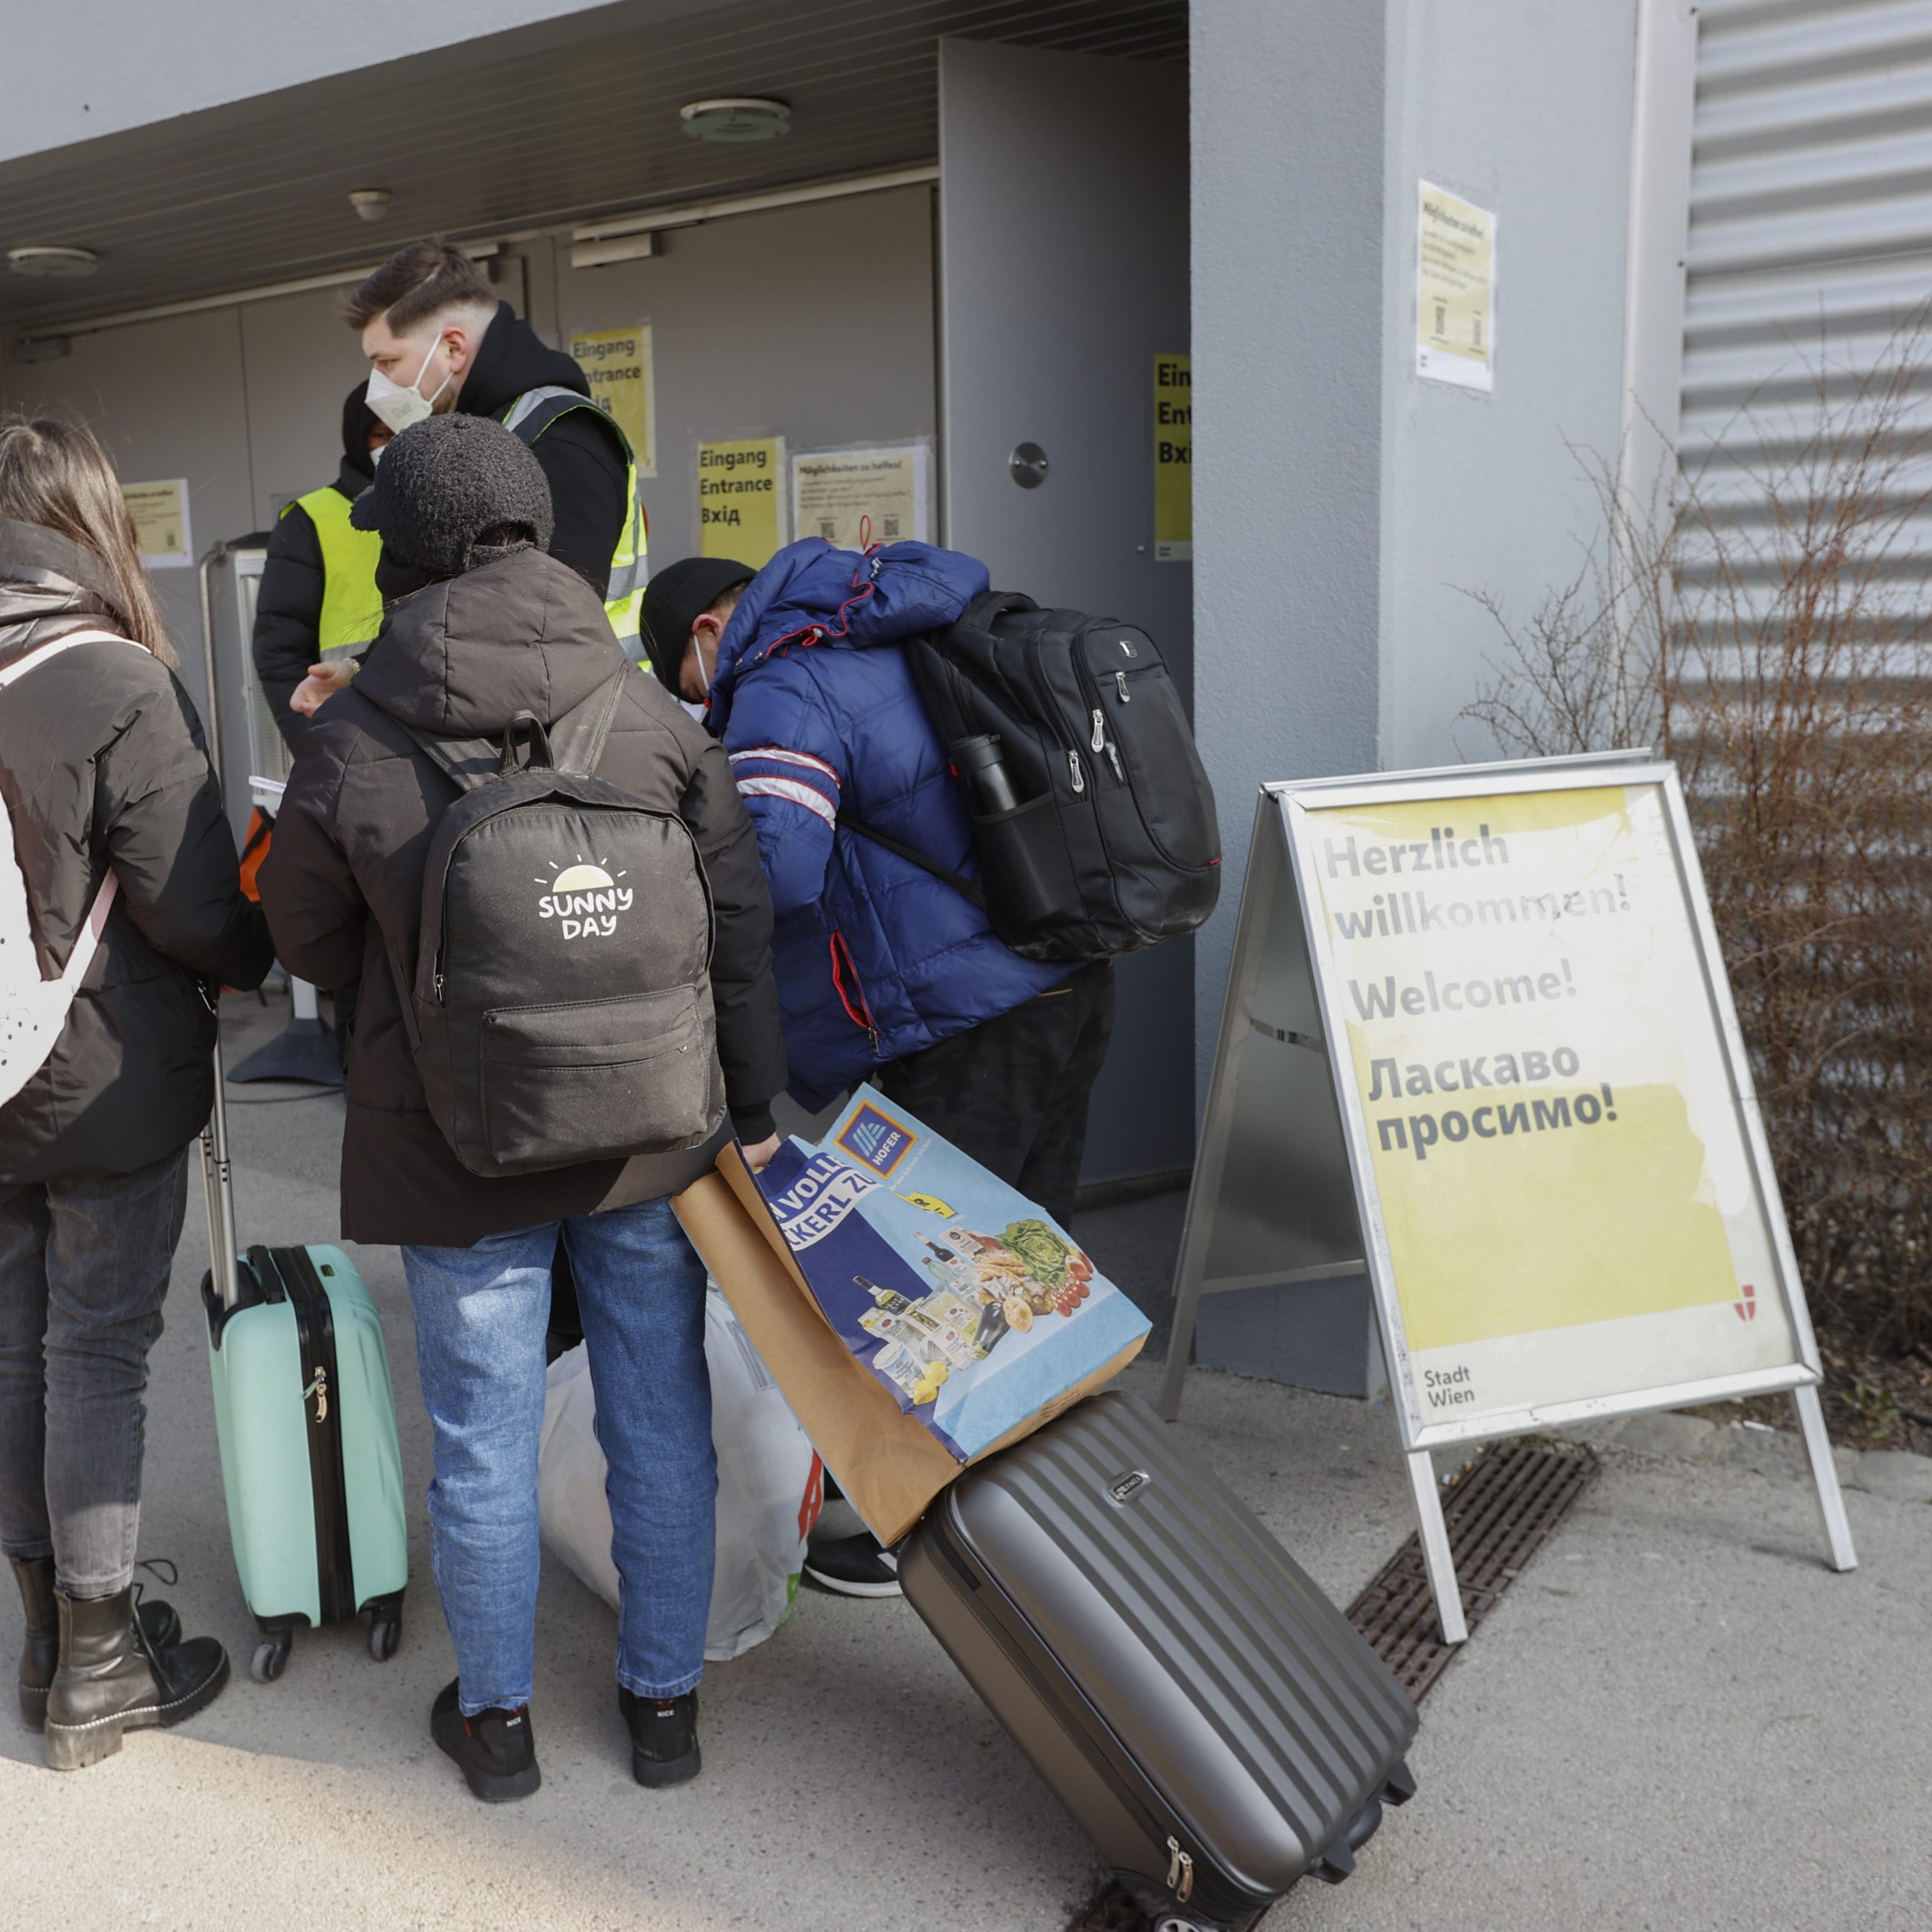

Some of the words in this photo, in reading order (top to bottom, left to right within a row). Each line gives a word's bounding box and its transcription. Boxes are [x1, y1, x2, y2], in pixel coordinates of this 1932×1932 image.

[574, 340, 635, 360] Eingang
[585, 367, 641, 384] ntrance
[1158, 363, 1191, 386] Ein
[701, 450, 767, 471] Eingang
[701, 478, 773, 495] Entrance
[702, 505, 740, 526] Вхід
[1323, 823, 1510, 878] Herzlich
[539, 887, 633, 918] SUNNY
[1334, 873, 1631, 940] willkommen!
[562, 915, 616, 940] DAY
[1347, 958, 1577, 1021] Welcome!
[1368, 1047, 1579, 1102] Ласкаво
[1376, 1082, 1617, 1161] просимо!
[872, 1132, 901, 1166] HOFER
[1424, 1365, 1471, 1388] Stadt
[1428, 1388, 1475, 1408] Wien
